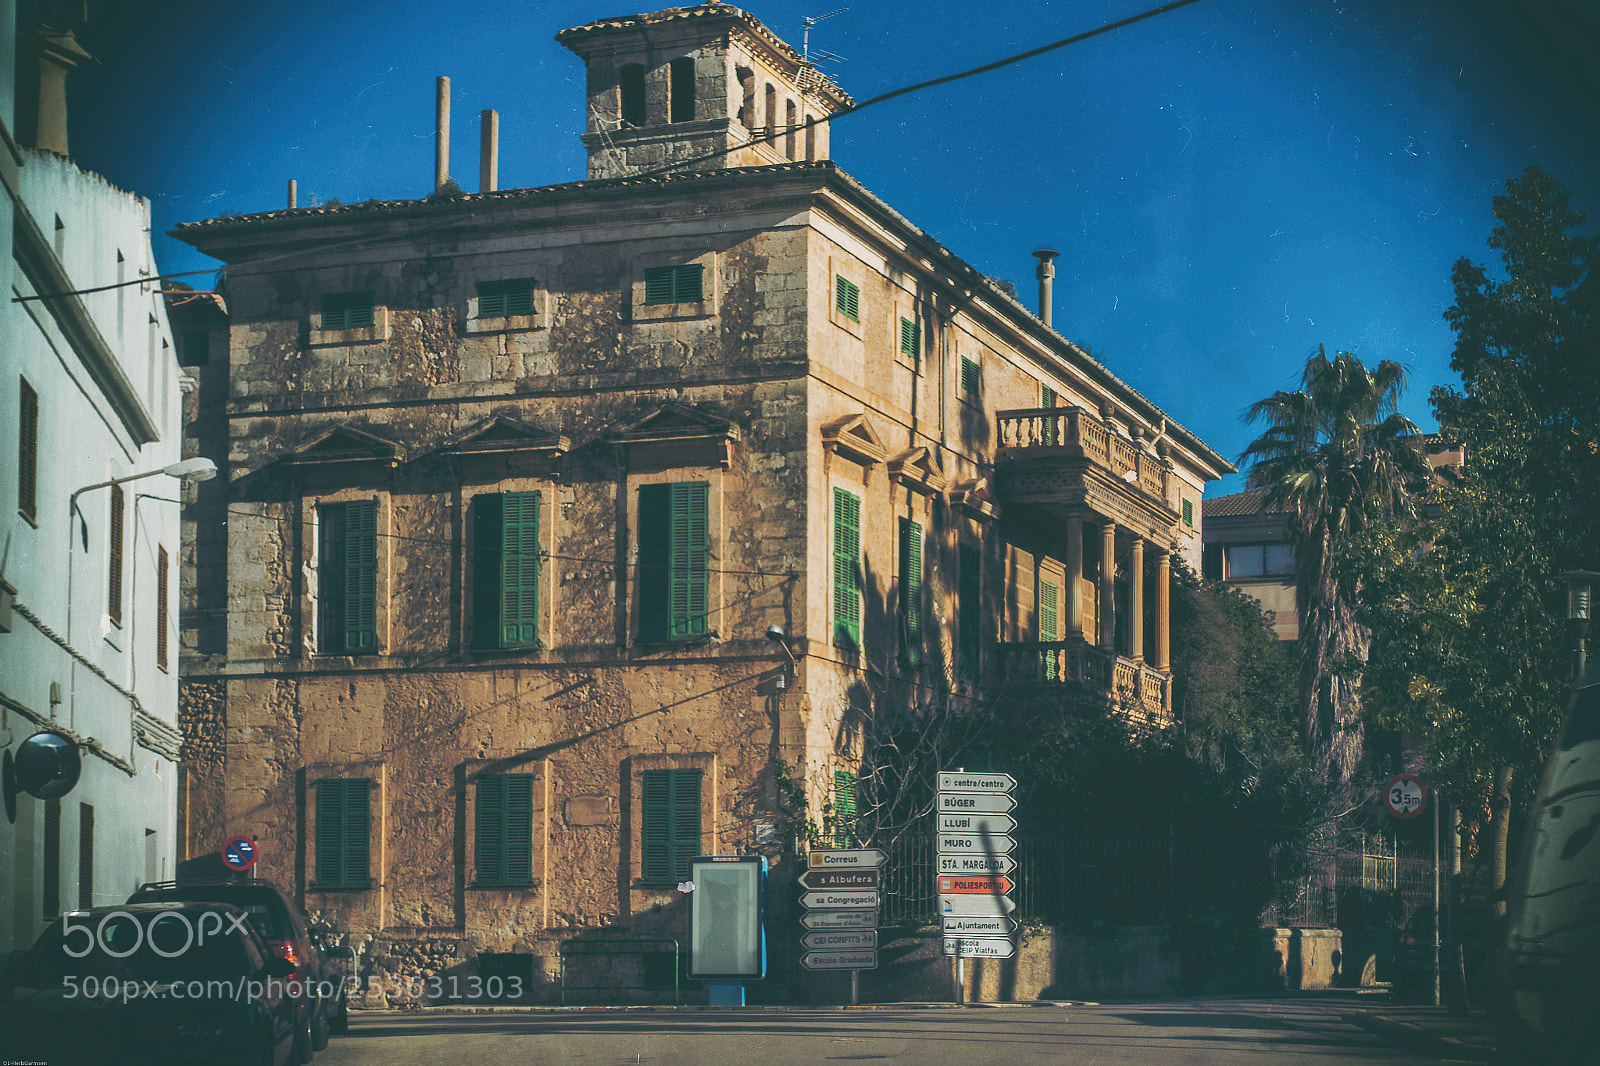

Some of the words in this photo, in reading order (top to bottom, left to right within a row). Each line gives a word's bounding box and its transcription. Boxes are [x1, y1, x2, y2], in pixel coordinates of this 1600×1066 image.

[954, 780, 1004, 788] centre/centro
[944, 797, 975, 808] BÚGER
[944, 818, 970, 827] LLUBÍ
[944, 839, 972, 848] MURO
[824, 855, 858, 864] Correus
[827, 896, 875, 905] Congregació
[957, 921, 1000, 930] Ajuntament
[814, 936, 826, 944] CEI
[828, 935, 860, 943] CONFITS
